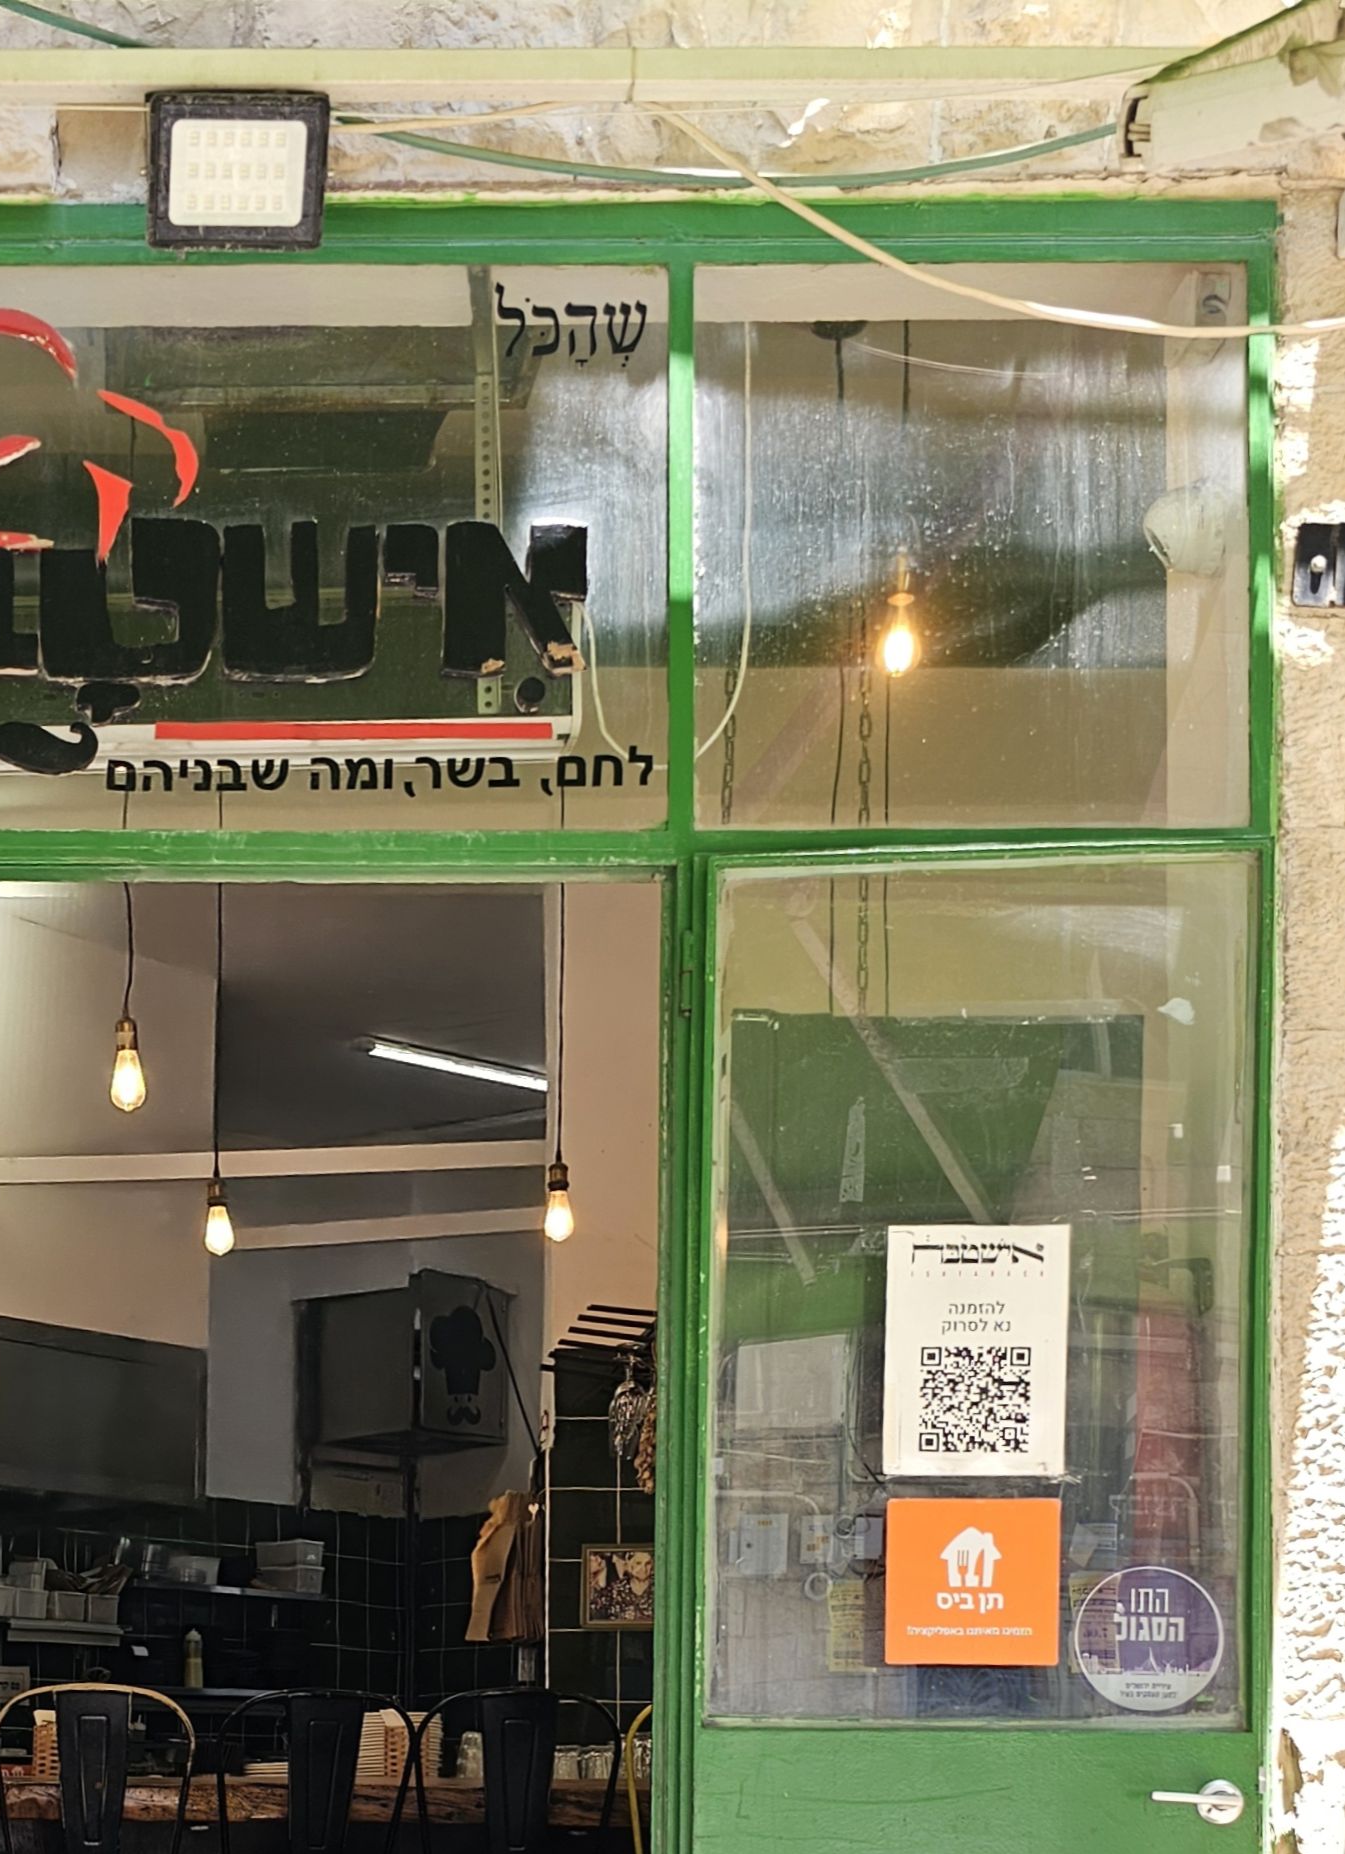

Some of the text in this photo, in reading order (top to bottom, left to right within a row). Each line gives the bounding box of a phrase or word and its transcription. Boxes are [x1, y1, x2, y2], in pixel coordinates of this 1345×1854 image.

[105, 757, 289, 792] שבניהם
[541, 746, 654, 797] לחם,
[948, 1300, 1006, 1315] להזמנה
[941, 1317, 1011, 1335] נא לסרוק
[936, 1592, 1004, 1614] תן ביס
[1131, 1588, 1169, 1613] התו
[1114, 1612, 1185, 1642] הסגול
